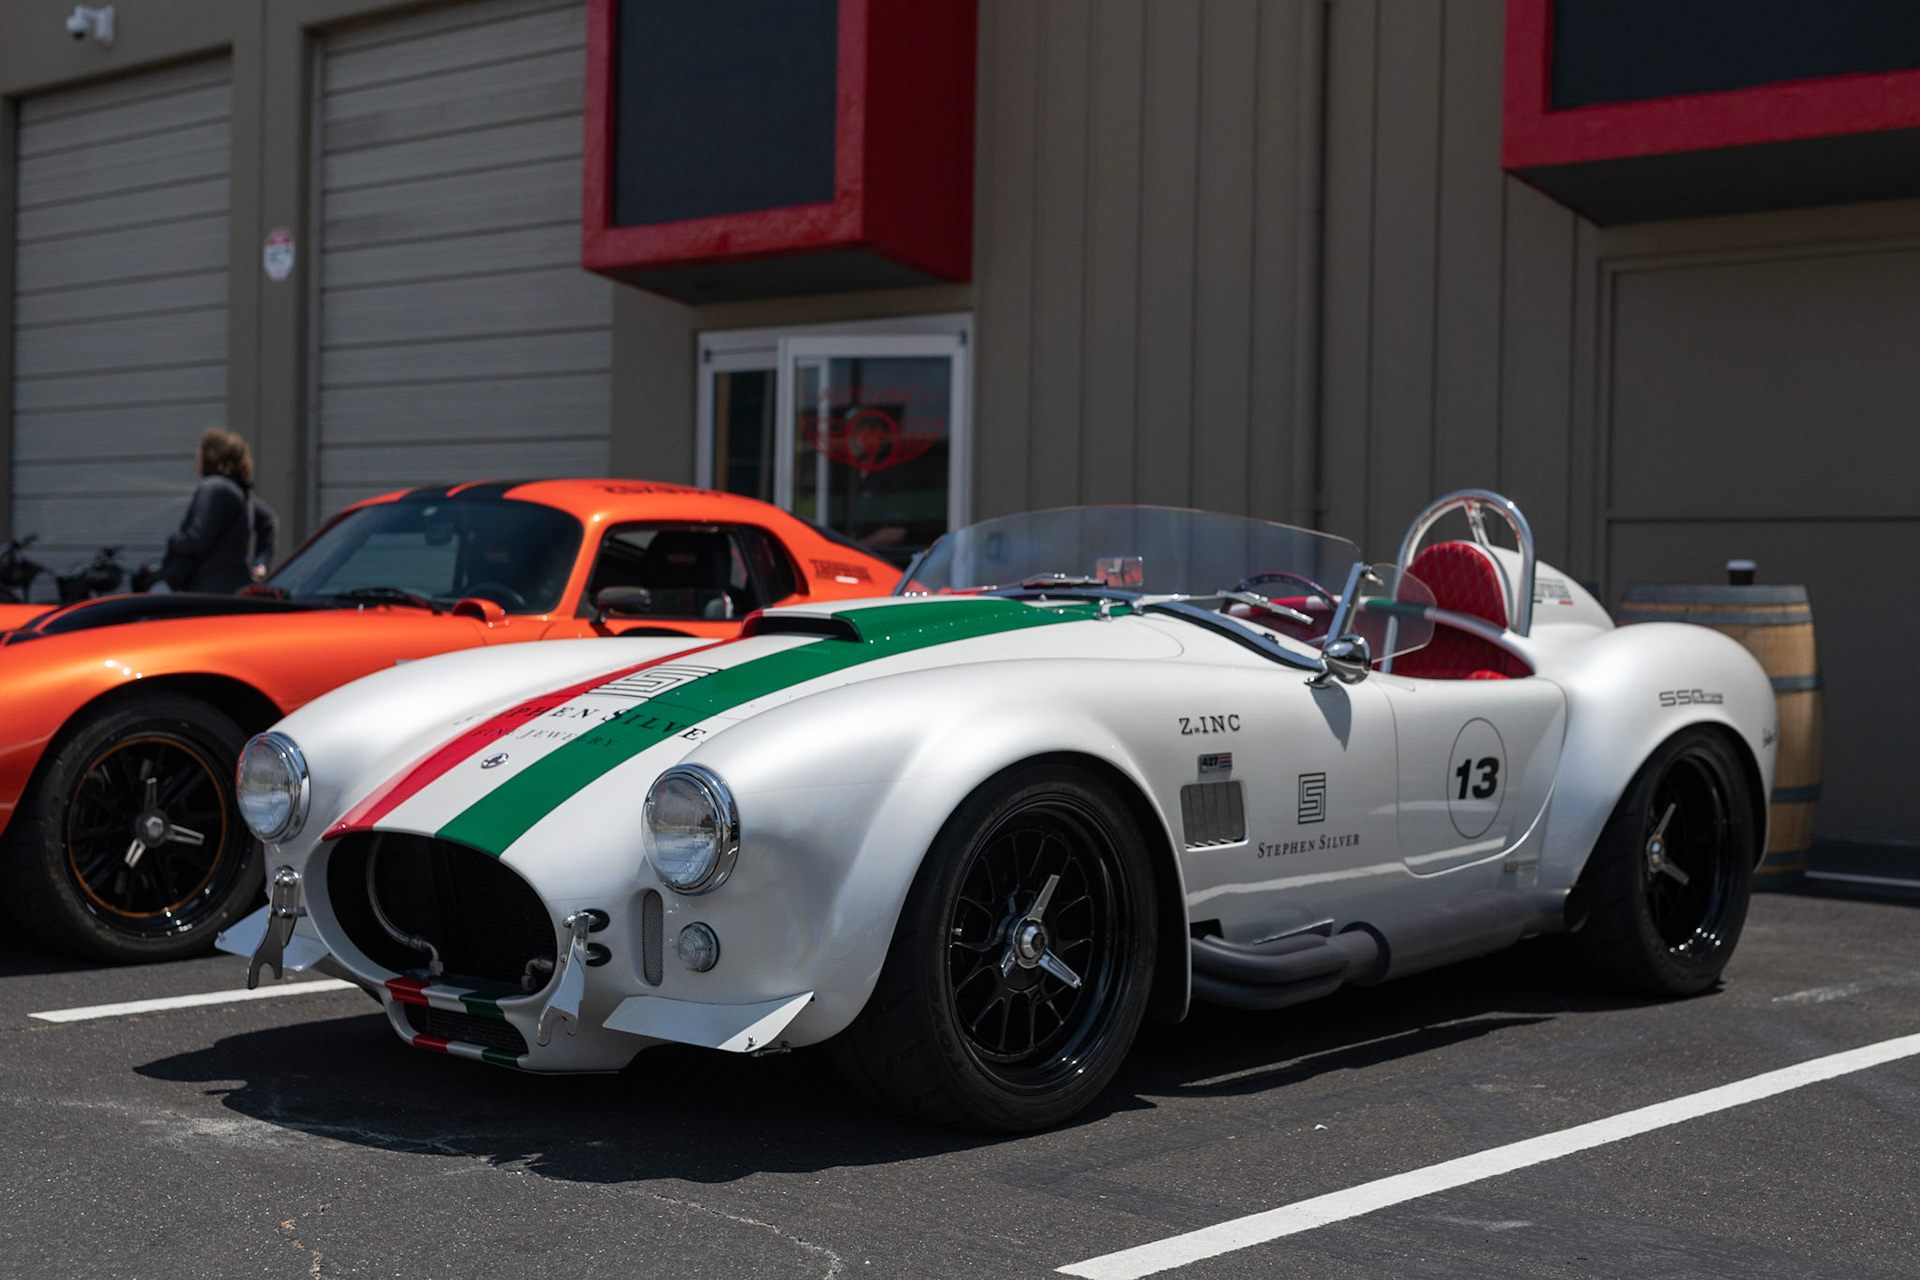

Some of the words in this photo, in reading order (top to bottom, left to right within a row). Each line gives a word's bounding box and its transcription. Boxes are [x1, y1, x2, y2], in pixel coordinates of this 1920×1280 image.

[601, 708, 707, 742] SILVE
[1202, 756, 1219, 767] 427
[1456, 757, 1499, 799] 13
[1257, 837, 1316, 858] STEPHEN
[1318, 834, 1360, 850] SILVER
